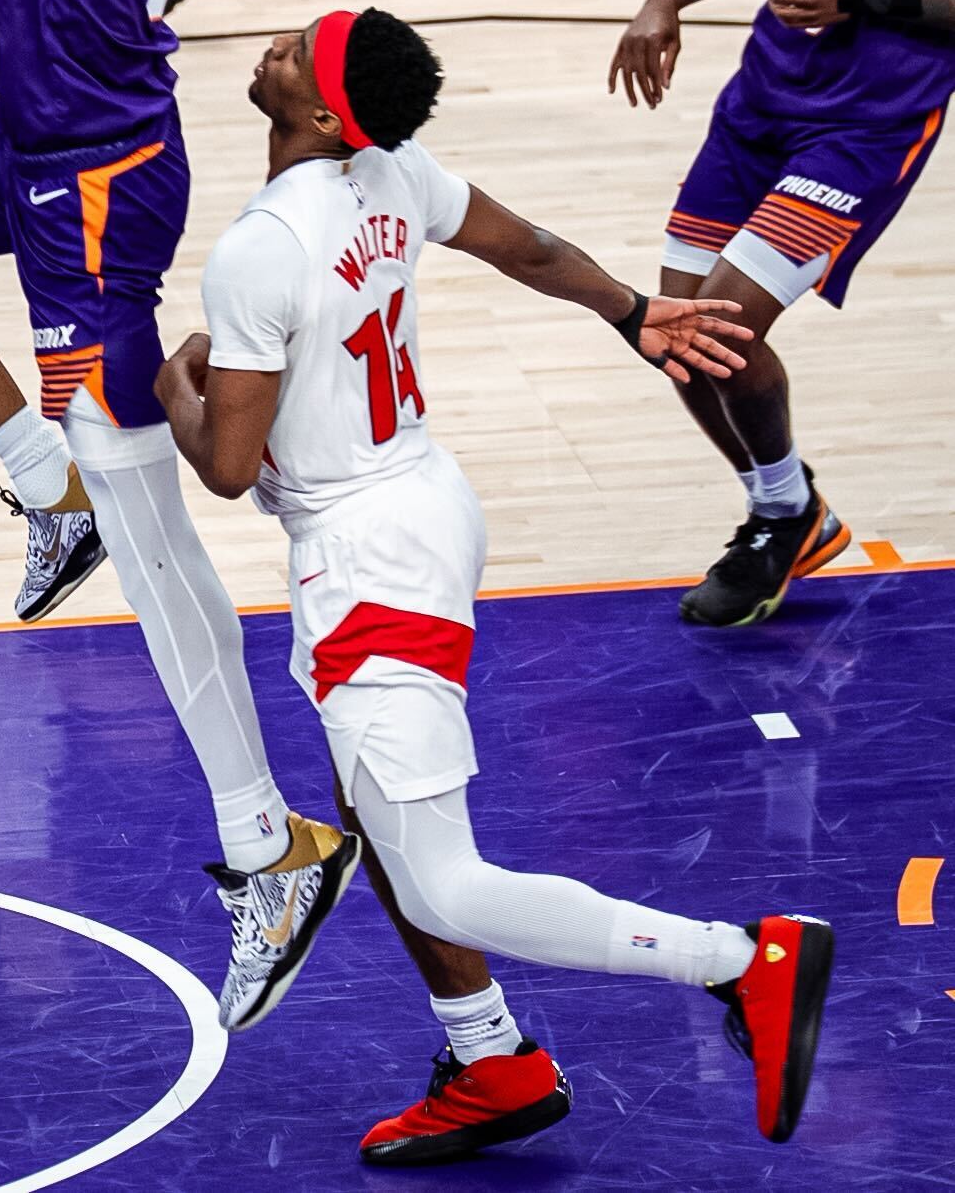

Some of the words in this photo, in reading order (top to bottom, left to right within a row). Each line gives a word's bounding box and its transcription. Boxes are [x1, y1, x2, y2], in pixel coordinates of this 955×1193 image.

[774, 174, 863, 214] PHOENIX
[333, 214, 408, 293] WALTER
[33, 323, 77, 349] ENIX
[341, 286, 426, 446] 14
